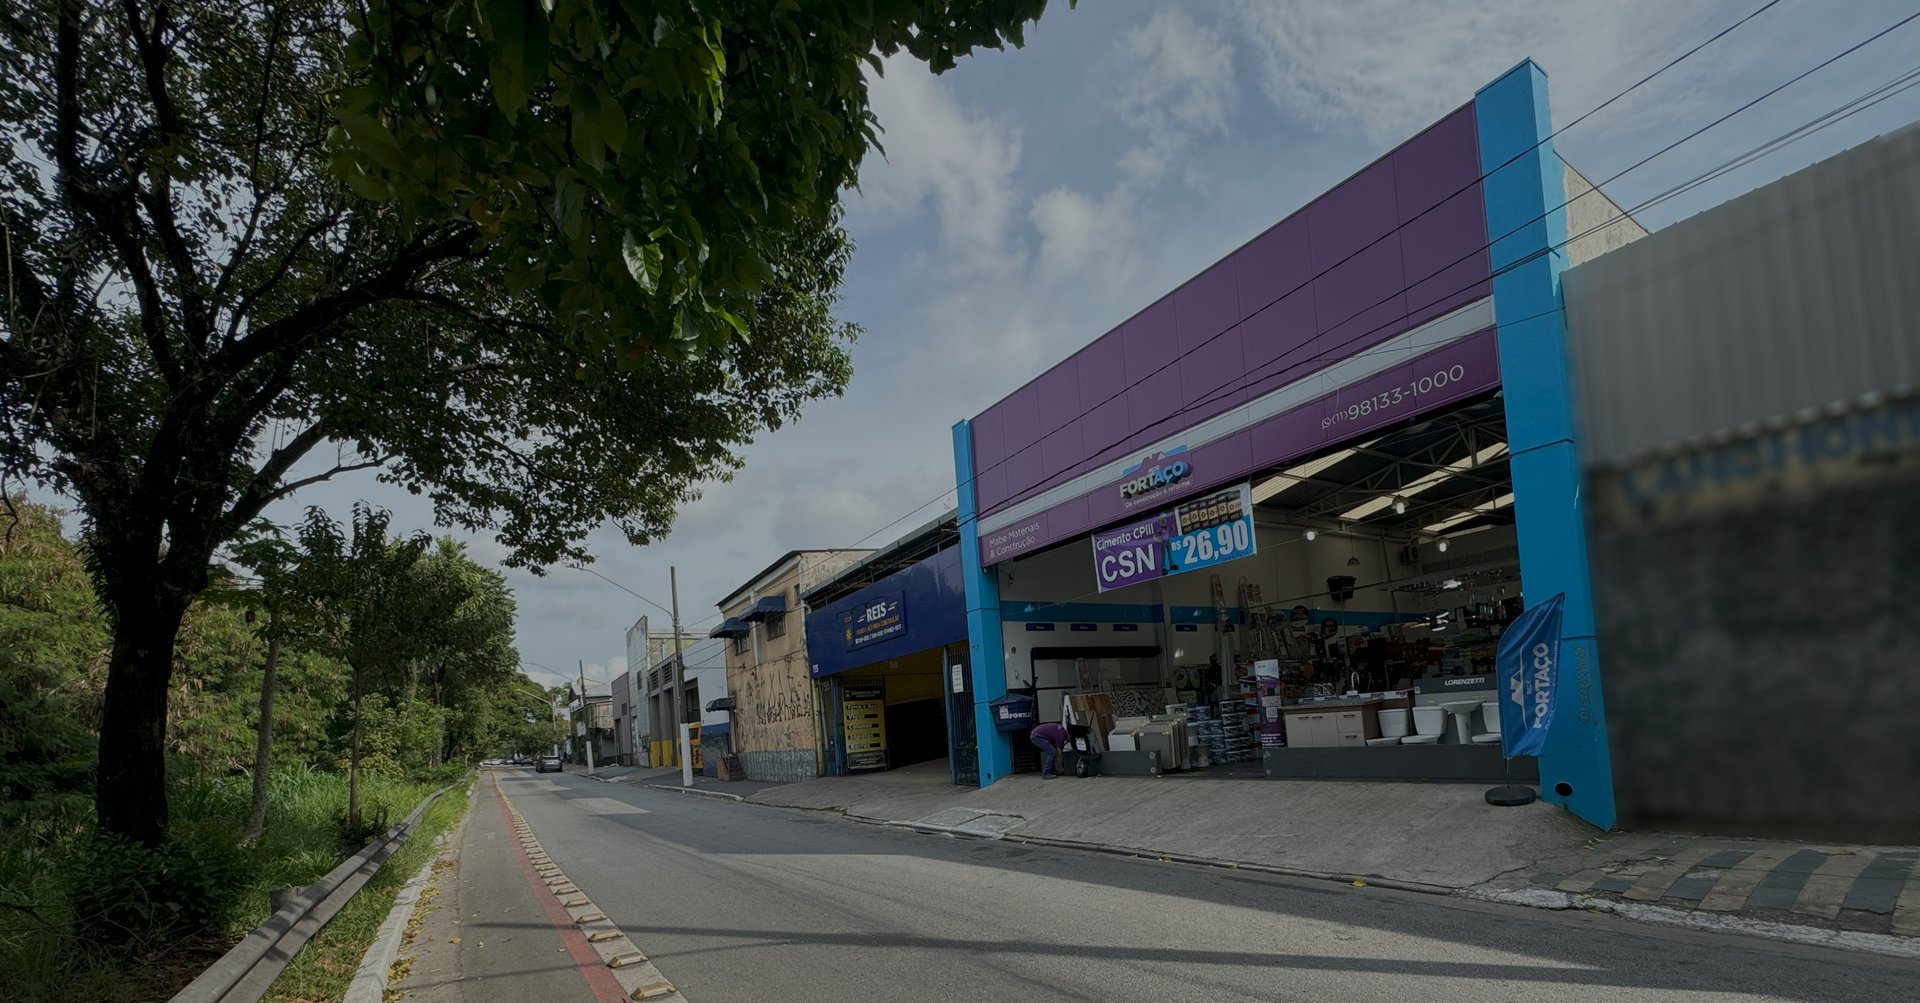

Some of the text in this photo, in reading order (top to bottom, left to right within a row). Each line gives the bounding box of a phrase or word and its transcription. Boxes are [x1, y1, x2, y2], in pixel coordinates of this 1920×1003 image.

[1120, 461, 1188, 497] FORTAÇO
[990, 535, 1007, 548] Mabe
[996, 536, 1035, 555] Construção
[1096, 523, 1155, 551] Cimento CPIII
[1182, 519, 1249, 565] 26,90
[1101, 543, 1156, 582] CSN
[866, 601, 887, 622] REIS
[1444, 677, 1485, 686] LORENZETTI
